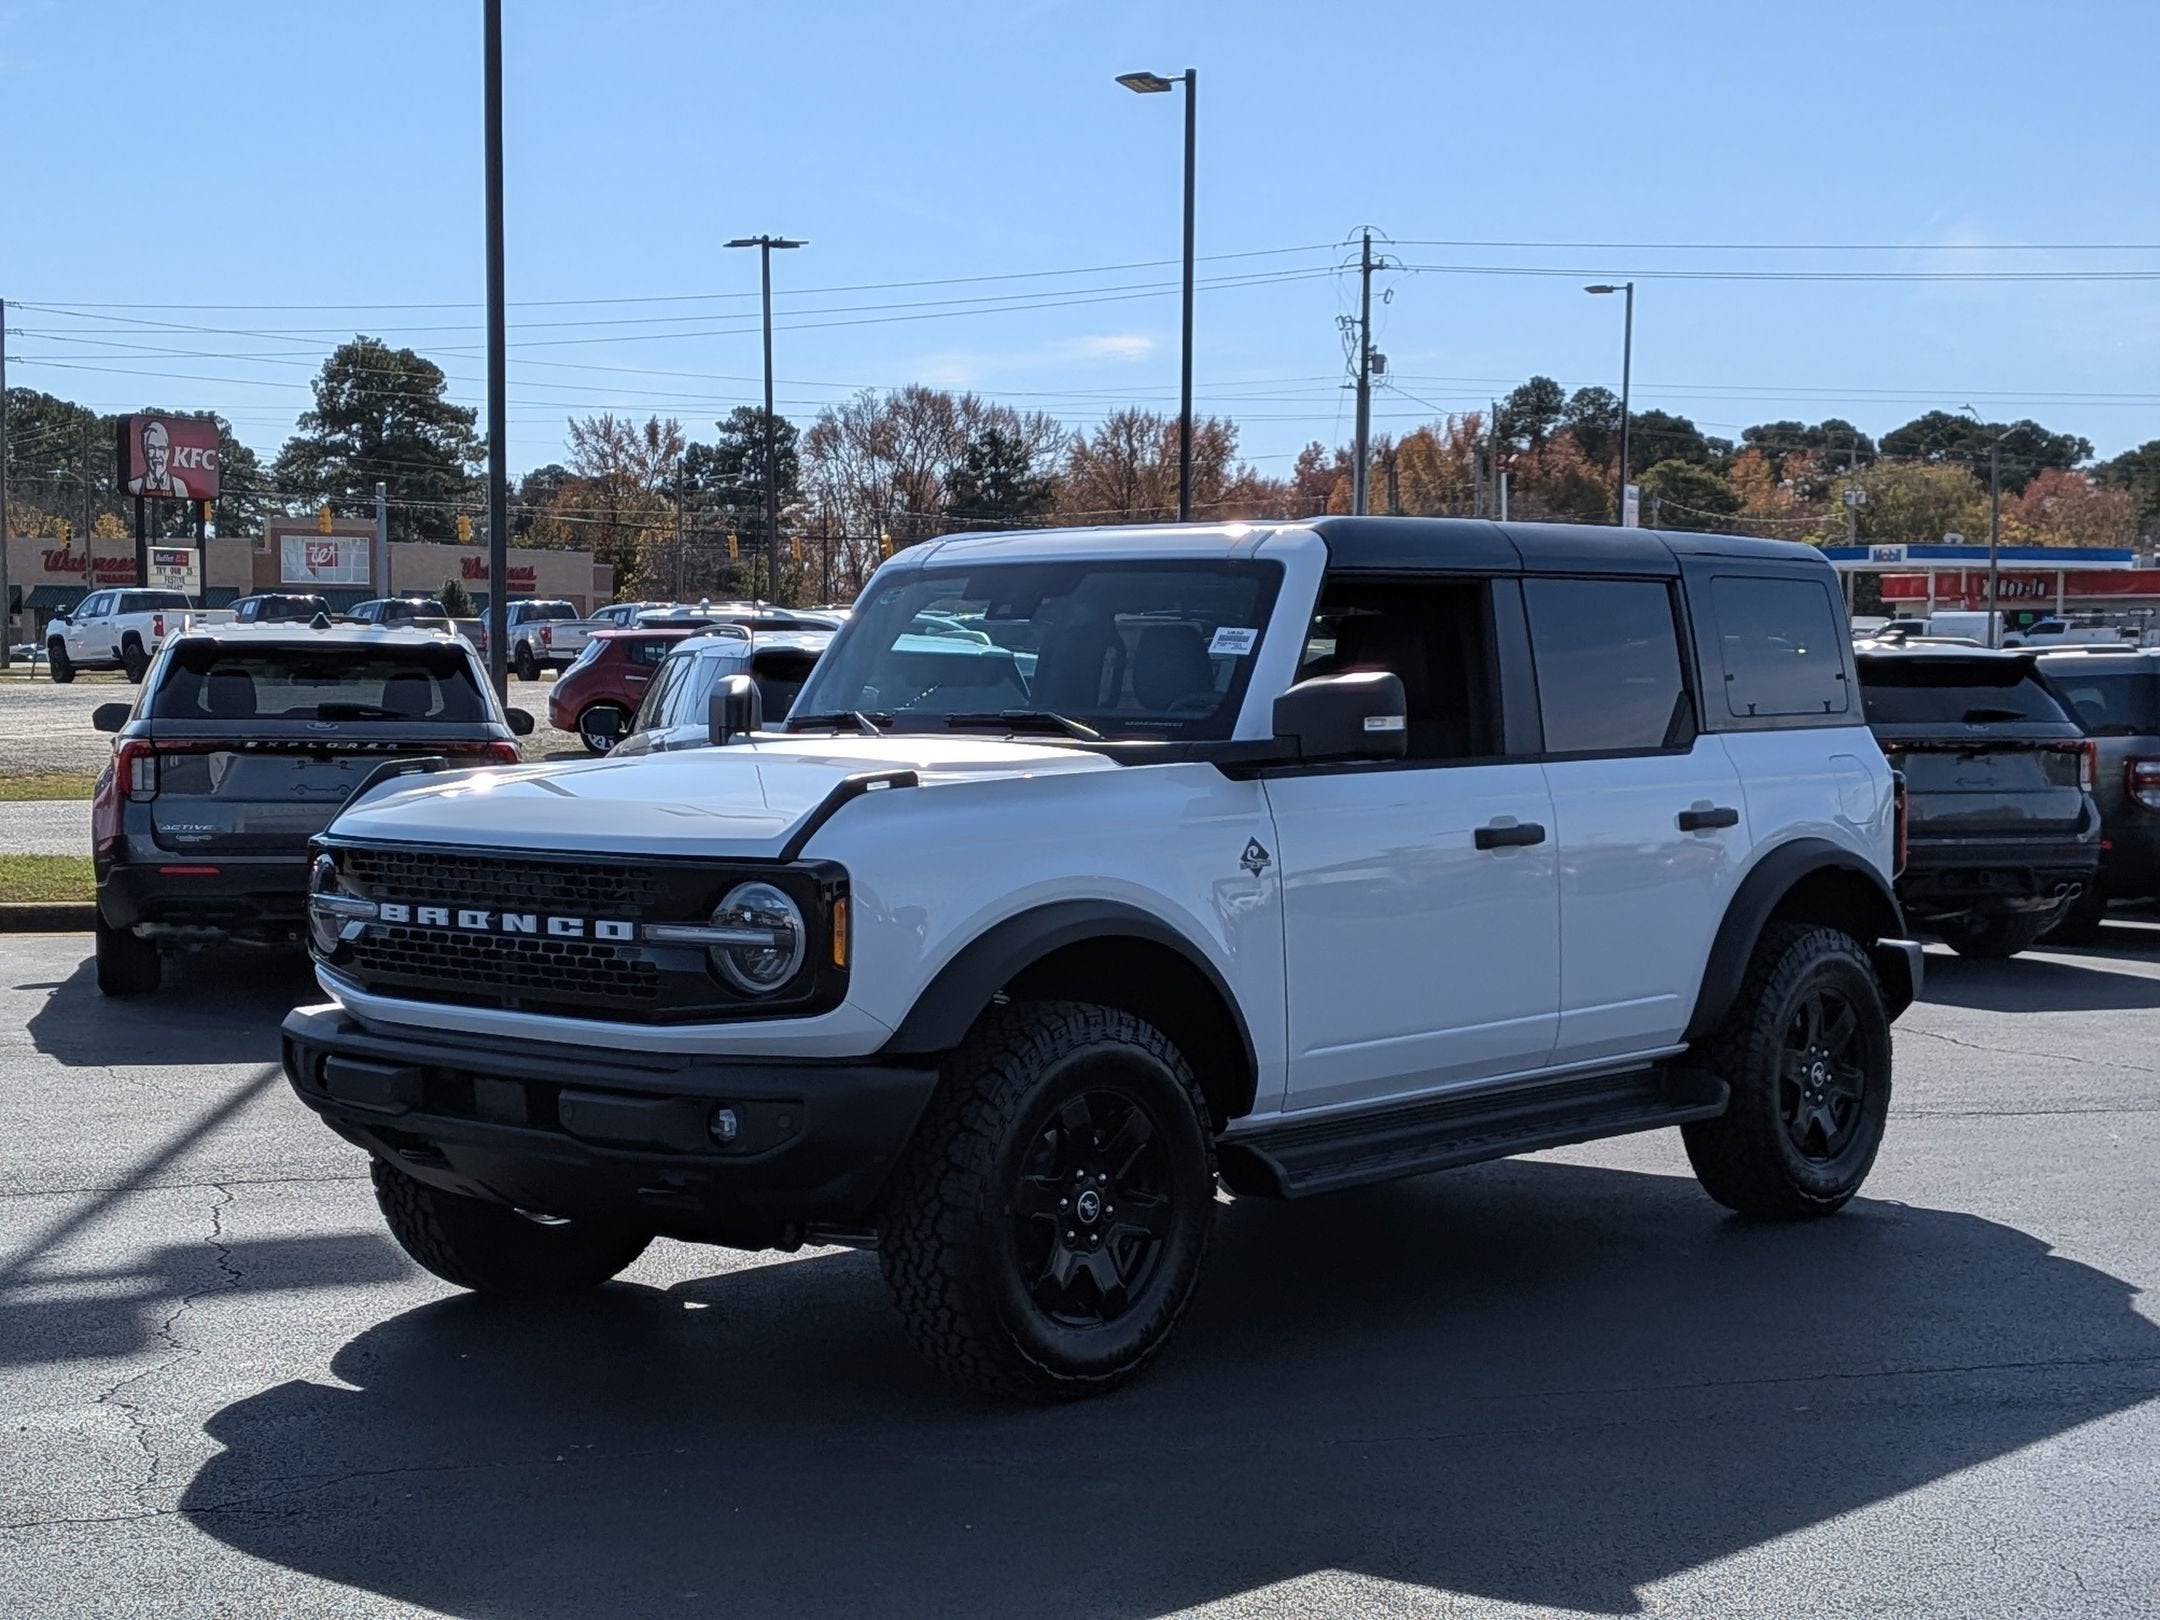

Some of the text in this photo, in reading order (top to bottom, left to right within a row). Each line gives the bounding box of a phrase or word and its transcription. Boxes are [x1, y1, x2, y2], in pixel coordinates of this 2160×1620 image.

[172, 446, 216, 470] KFC
[1873, 549, 1902, 562] Mobil
[246, 741, 398, 749] EXPLORER
[380, 903, 633, 941] BRONCO
